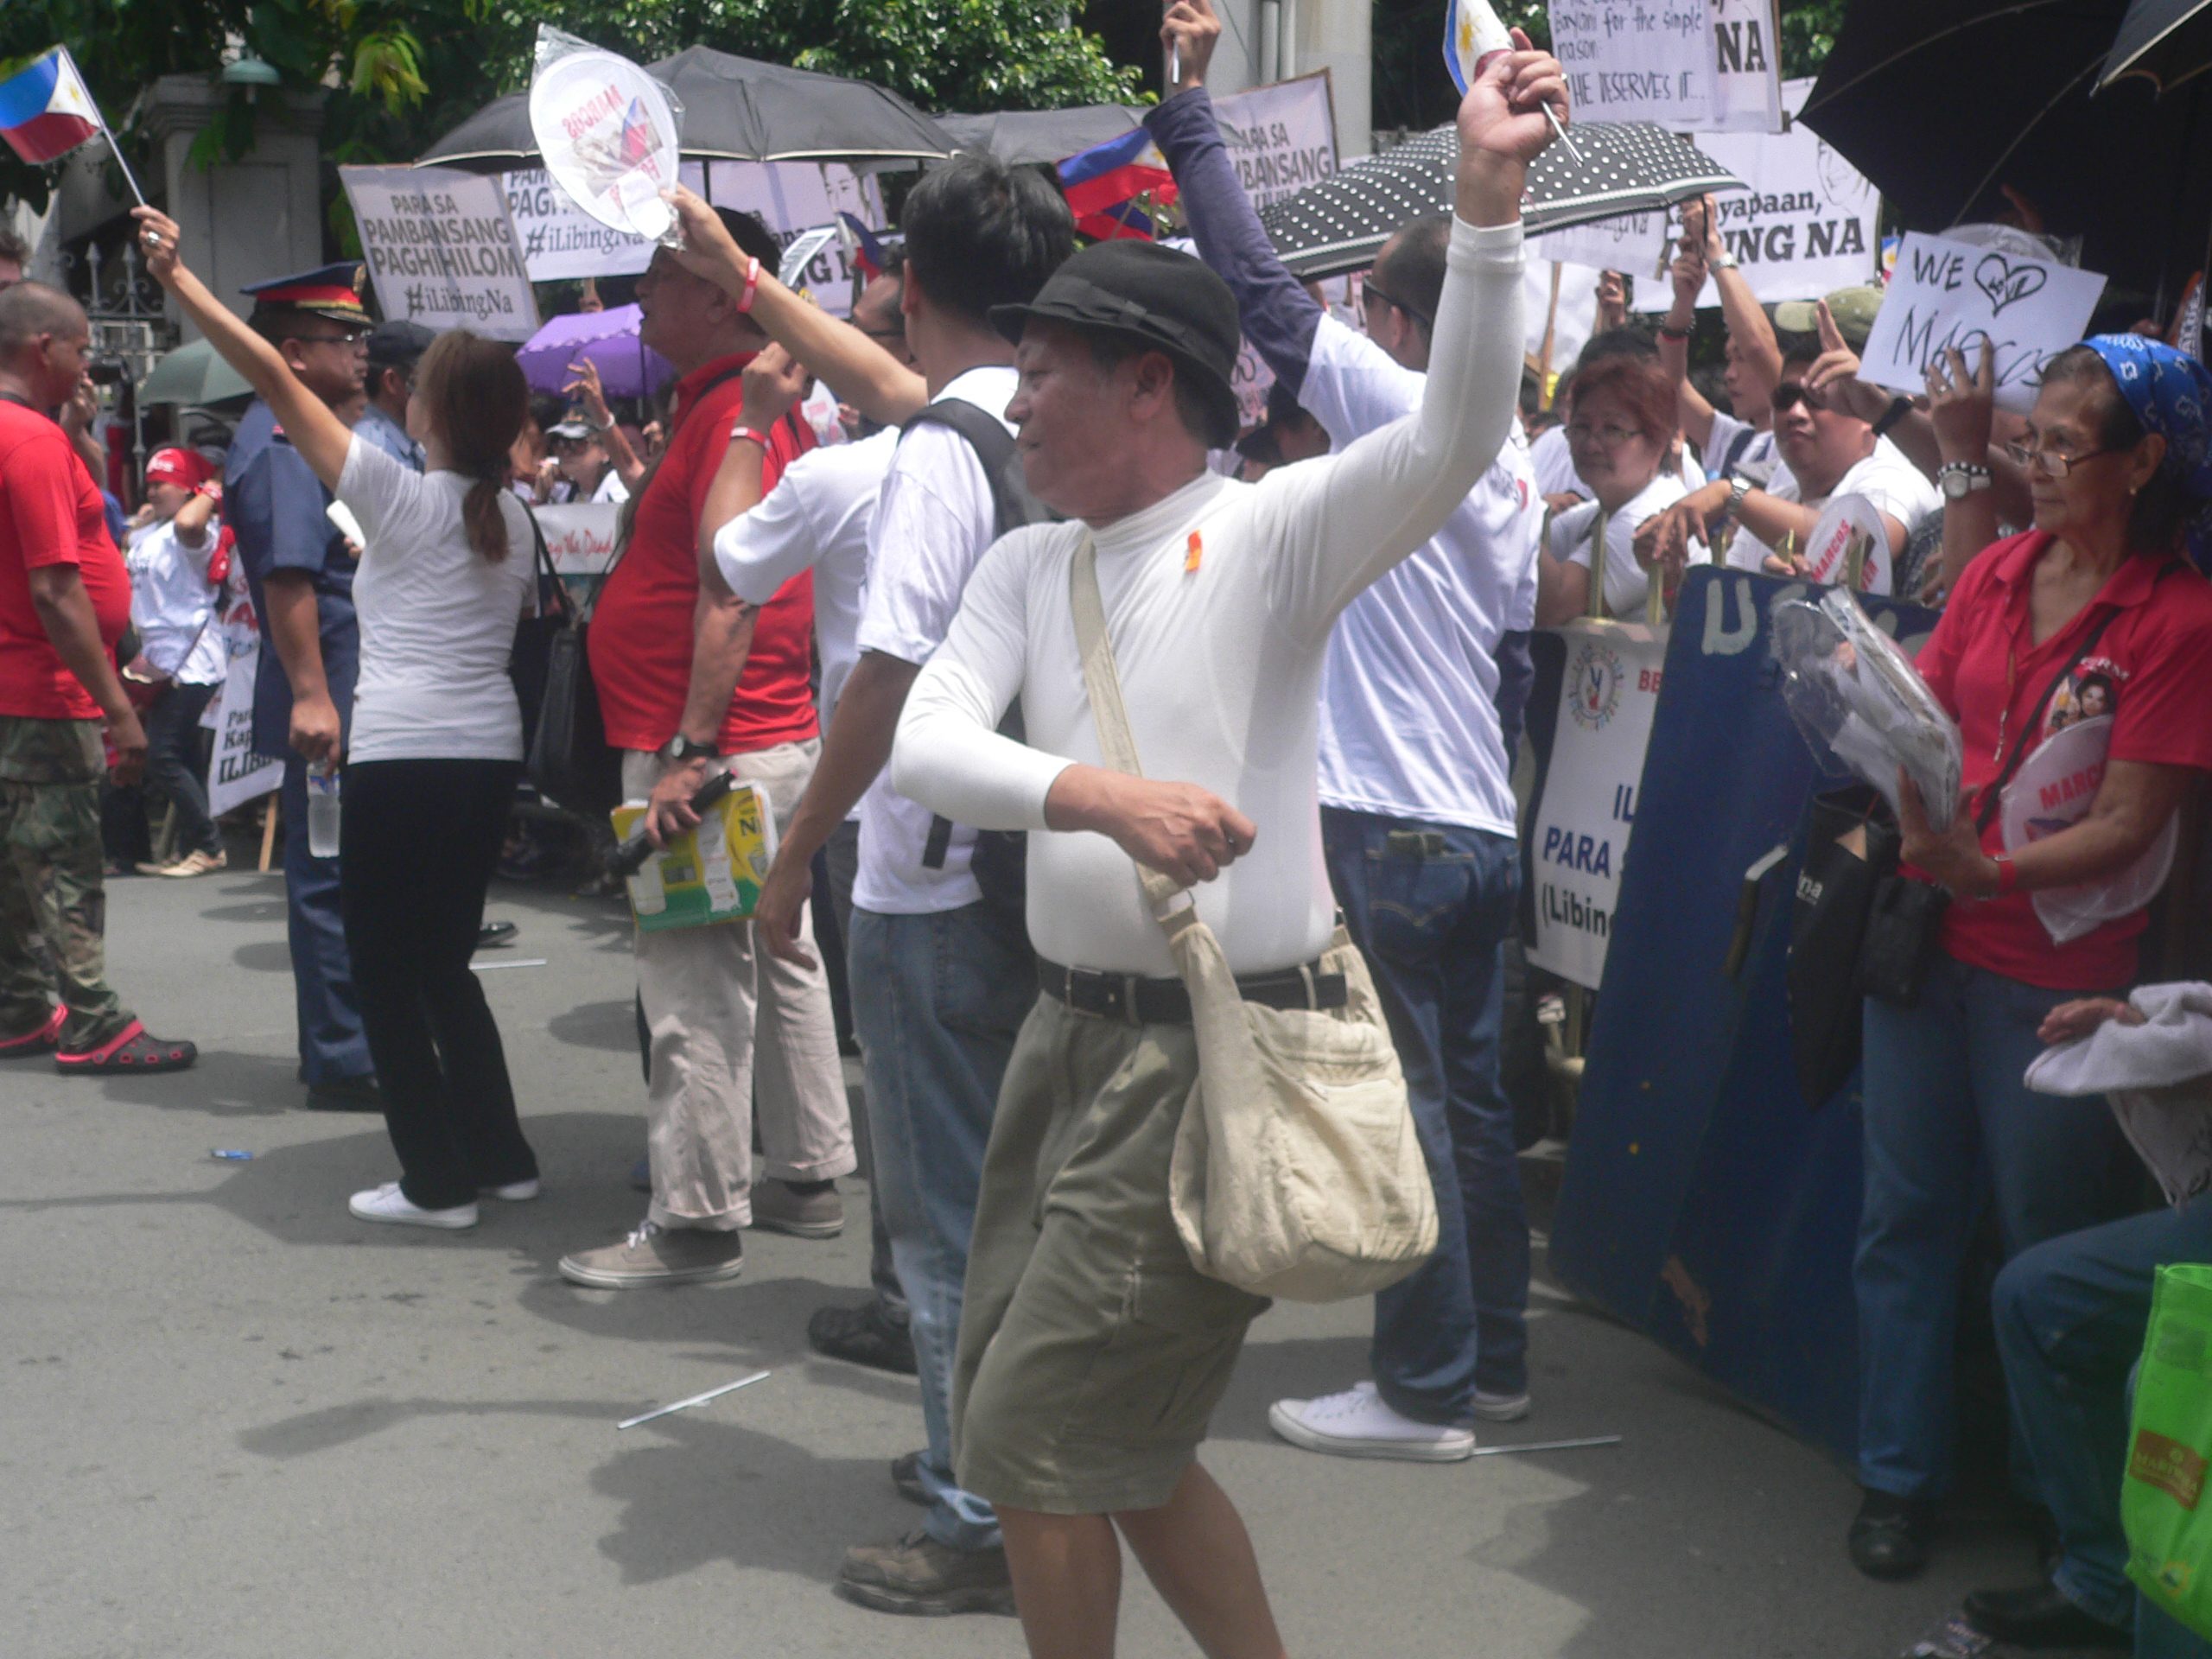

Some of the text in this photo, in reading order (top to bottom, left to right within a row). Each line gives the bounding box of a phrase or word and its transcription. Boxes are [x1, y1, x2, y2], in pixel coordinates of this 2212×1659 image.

[1603, 6, 1627, 38] for
[1714, 19, 1768, 73] NA
[1573, 72, 1593, 107] HE
[1235, 145, 1333, 192] BANSANG
[390, 194, 459, 216] PARA SA
[364, 217, 511, 247] PAMBANSANG
[1805, 217, 1866, 259] NA
[371, 246, 522, 279] PAGHIHILOM
[1913, 247, 1966, 292] WE
[404, 283, 514, 321] #iLibingNa
[1811, 518, 1852, 583] MARCOS
[1543, 826, 1611, 880] PARA
